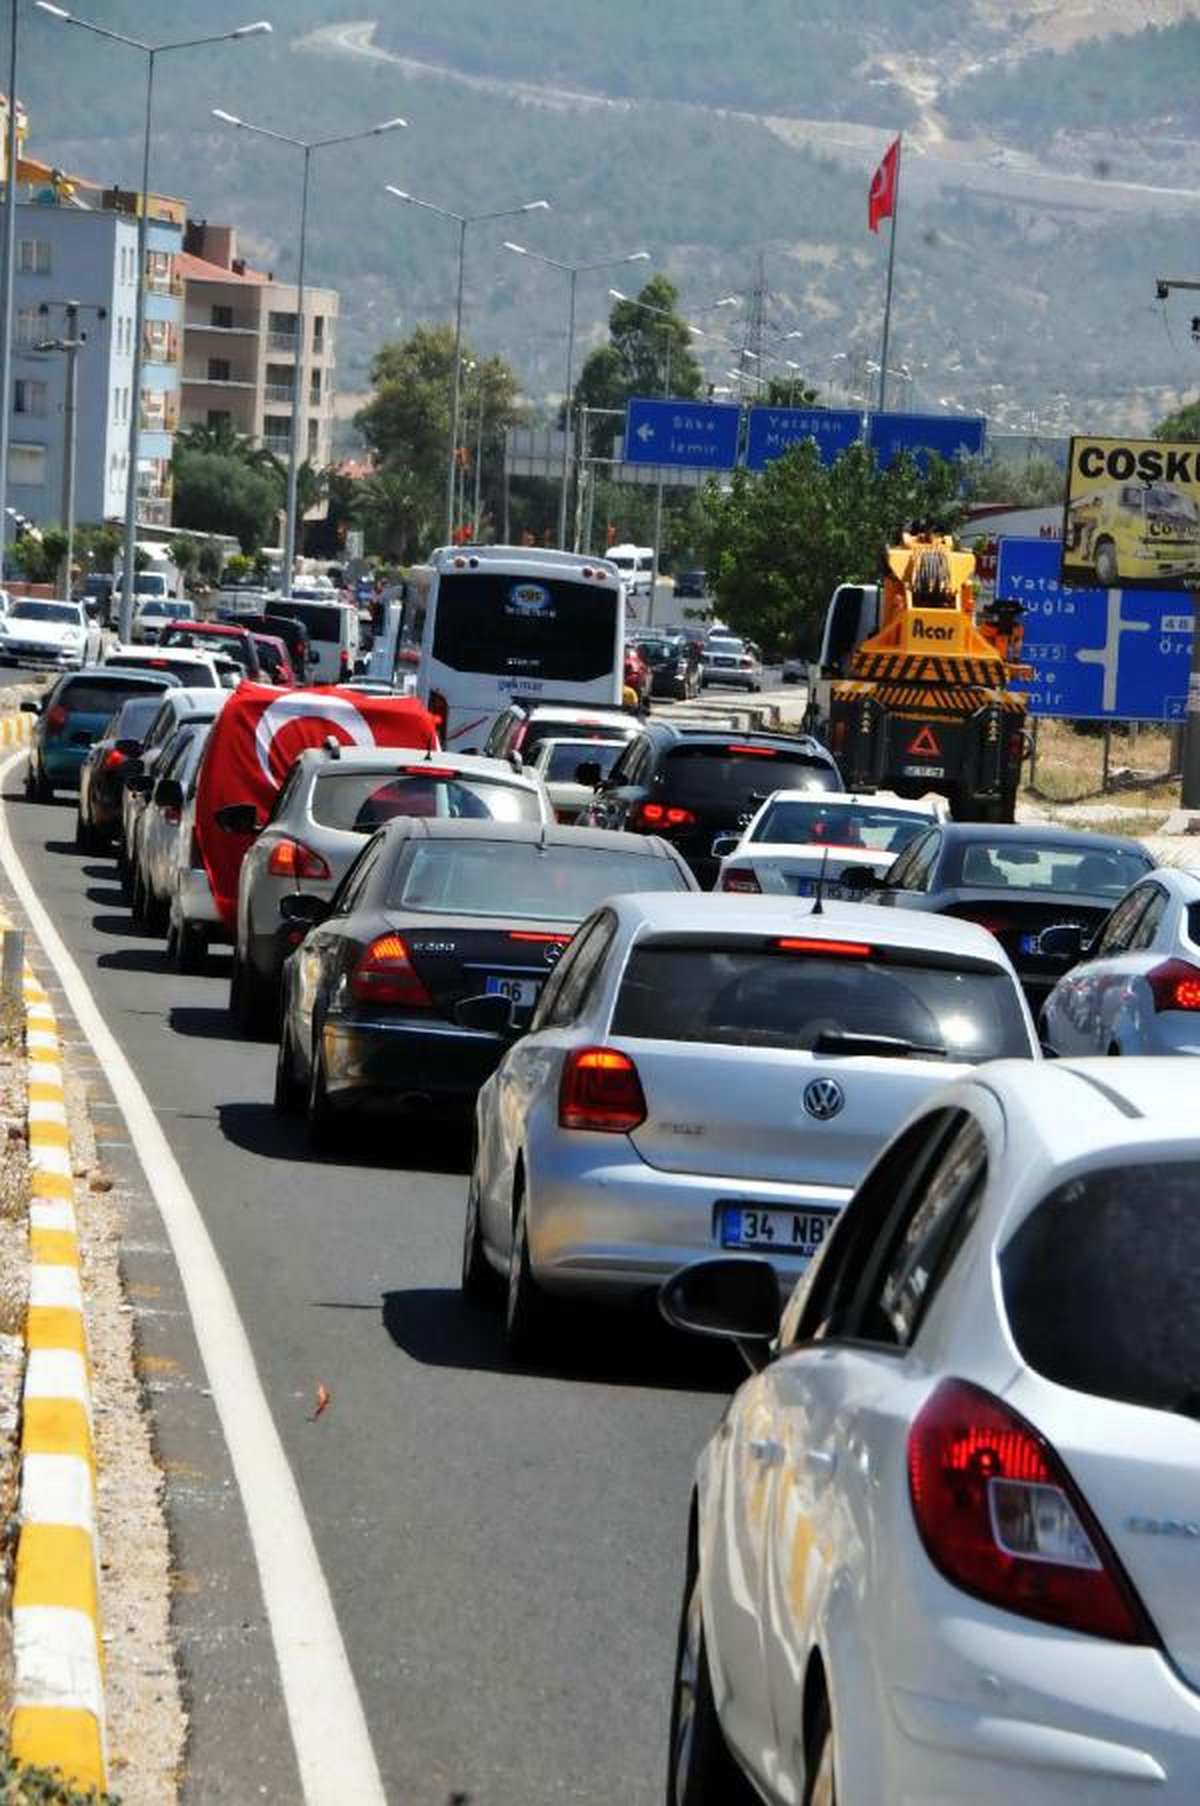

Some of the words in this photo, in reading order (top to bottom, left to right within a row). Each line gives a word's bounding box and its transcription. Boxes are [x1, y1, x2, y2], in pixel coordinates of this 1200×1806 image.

[1078, 446, 1200, 490] COŞK
[912, 618, 955, 641] Acar
[743, 1213, 775, 1241] 34
